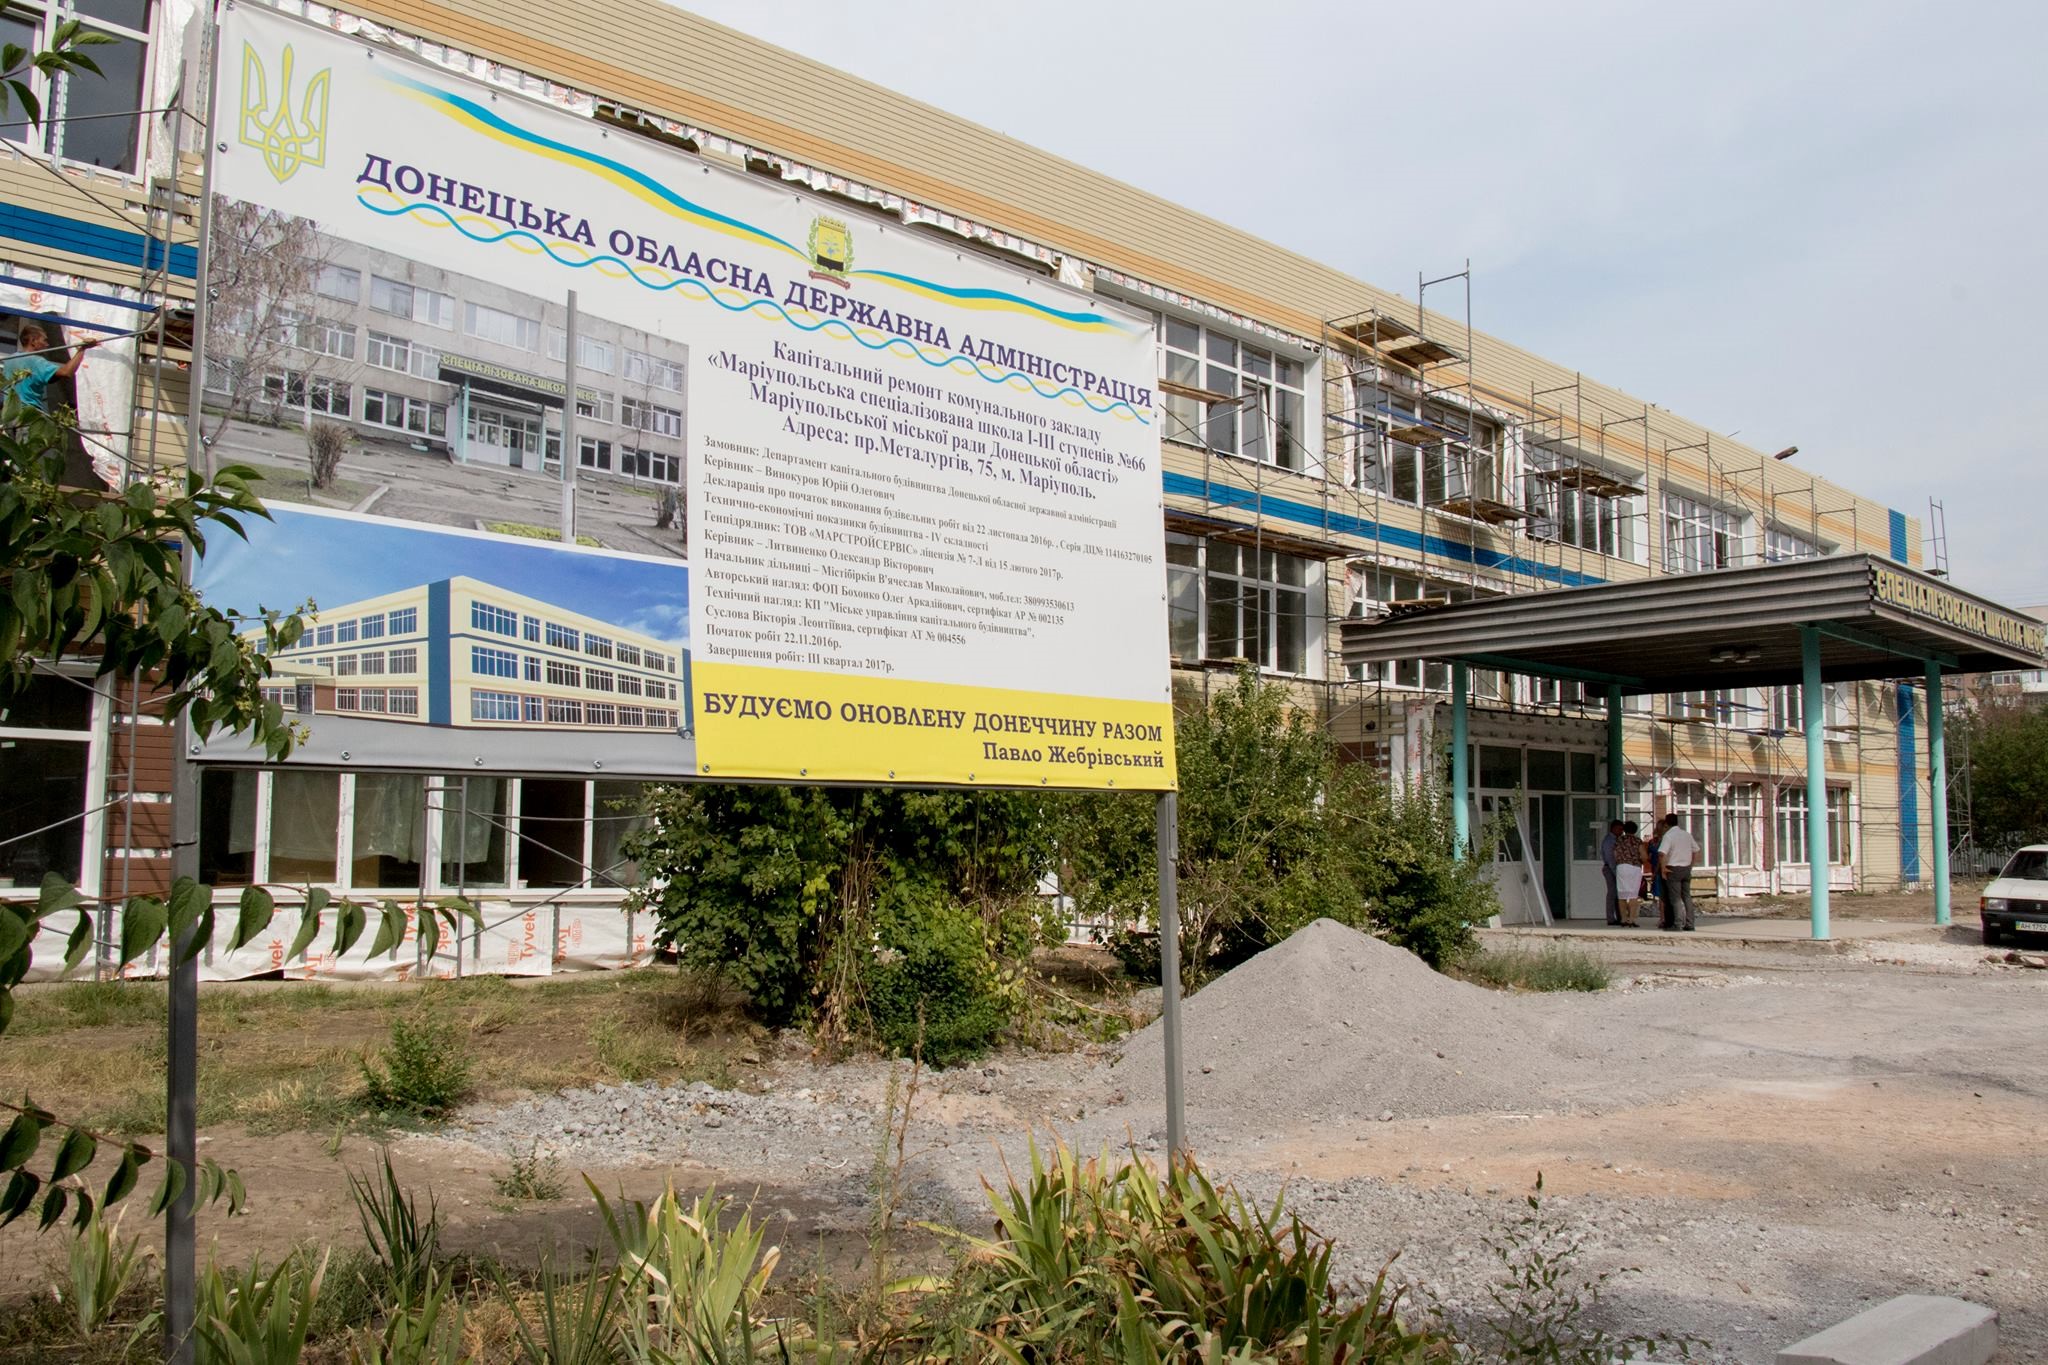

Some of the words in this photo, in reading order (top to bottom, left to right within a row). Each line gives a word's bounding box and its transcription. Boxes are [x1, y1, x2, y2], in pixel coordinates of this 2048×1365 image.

[356, 152, 596, 248] ДОНЕЦЬКА
[609, 229, 775, 299] ОБЛАСНА
[783, 280, 952, 350] ДЕРЖАВНА
[958, 334, 1153, 409] АДМІНІСТРАЦІЯ
[537, 378, 567, 395] ШКОЛ
[773, 340, 883, 386] Капітальний
[888, 375, 944, 401] ремонт
[947, 391, 1047, 429] комунального
[1050, 419, 1101, 446] закладу
[749, 381, 888, 431] Маріупольської
[892, 419, 949, 446] міської
[952, 435, 986, 455] ради
[989, 440, 1062, 472] Донецької
[860, 391, 974, 431] спеціалізована
[978, 420, 1024, 443] школа
[1058, 441, 1114, 465] ступенів
[1116, 451, 1146, 472] №66
[703, 434, 760, 457] Замовник:
[761, 447, 828, 470] Департамент
[830, 463, 892, 484] капітального
[893, 474, 947, 495] будівництва
[947, 486, 991, 504] Донецької
[992, 496, 1026, 512] обласної
[704, 453, 754, 474] Керівник
[765, 465, 820, 487] Винокуров
[822, 476, 849, 493] Юрій
[850, 482, 895, 501] Олегович
[782, 415, 849, 445] Адреса:
[977, 458, 998, 480] 75,
[1001, 468, 1016, 482] м.
[1019, 467, 1096, 500] Маріуполь.
[703, 472, 765, 494] Декларація
[767, 486, 787, 500] про
[788, 490, 829, 506] початок
[830, 498, 882, 516] виконання
[883, 506, 937, 526] будівельних
[938, 518, 960, 530] робіт
[962, 521, 975, 533] від
[976, 523, 986, 535] 22
[987, 528, 1029, 543] листопада
[1059, 539, 1082, 553] Серія
[703, 490, 814, 521] Технично-економічні
[816, 513, 867, 530] показники
[868, 520, 924, 540] будівництва
[943, 536, 989, 552] складності
[704, 509, 781, 533] Генпідрядник:
[783, 522, 807, 537] ТОВ
[919, 547, 955, 562] ліцензія
[984, 557, 997, 569] від
[999, 559, 1009, 571] 15
[1009, 564, 1038, 575] лютого
[1039, 566, 1064, 582] 2017р.
[704, 528, 755, 547] Керівник
[764, 538, 828, 558] Литвиненко
[829, 548, 881, 569] Олександр
[883, 556, 934, 575] Вікторович
[704, 547, 765, 567] Начальник
[766, 557, 811, 574] дільниці
[925, 580, 988, 600] Миколайович,
[704, 567, 769, 586] Авторський
[771, 578, 810, 592] нагляд:
[812, 581, 839, 596] ФОП
[882, 591, 905, 604] Олег
[907, 595, 966, 613] Аркадійович,
[966, 605, 1012, 619] сертифікат
[704, 584, 761, 603] Технічний
[763, 595, 802, 609] нагляд:
[804, 597, 821, 611] КП
[865, 608, 918, 623] управління
[919, 615, 977, 630] капітального
[705, 604, 750, 621] Суслова
[752, 609, 797, 628] Вікторія
[798, 615, 856, 633] Леонтіївна,
[856, 625, 908, 640] сертифікат
[706, 623, 752, 640] Початок
[754, 630, 781, 643] робіт
[1876, 568, 1985, 633] СПЕЦІАЛІЗОВАНА
[1985, 609, 2023, 646] ШКОЛА
[706, 642, 772, 660] Завершення
[774, 650, 805, 664] робіт:
[823, 656, 863, 670] квартал
[865, 658, 895, 674] 2017р.
[703, 692, 833, 721] БУДУЄМО
[840, 702, 967, 730] ОНОВЛЕНУ
[972, 712, 1097, 738] ДОНЕЧЧИНУ
[1101, 721, 1163, 743] РАЗОМ
[982, 741, 1043, 763] Павло
[1047, 745, 1165, 770] Жебрівський
[519, 911, 536, 961] Tyvek
